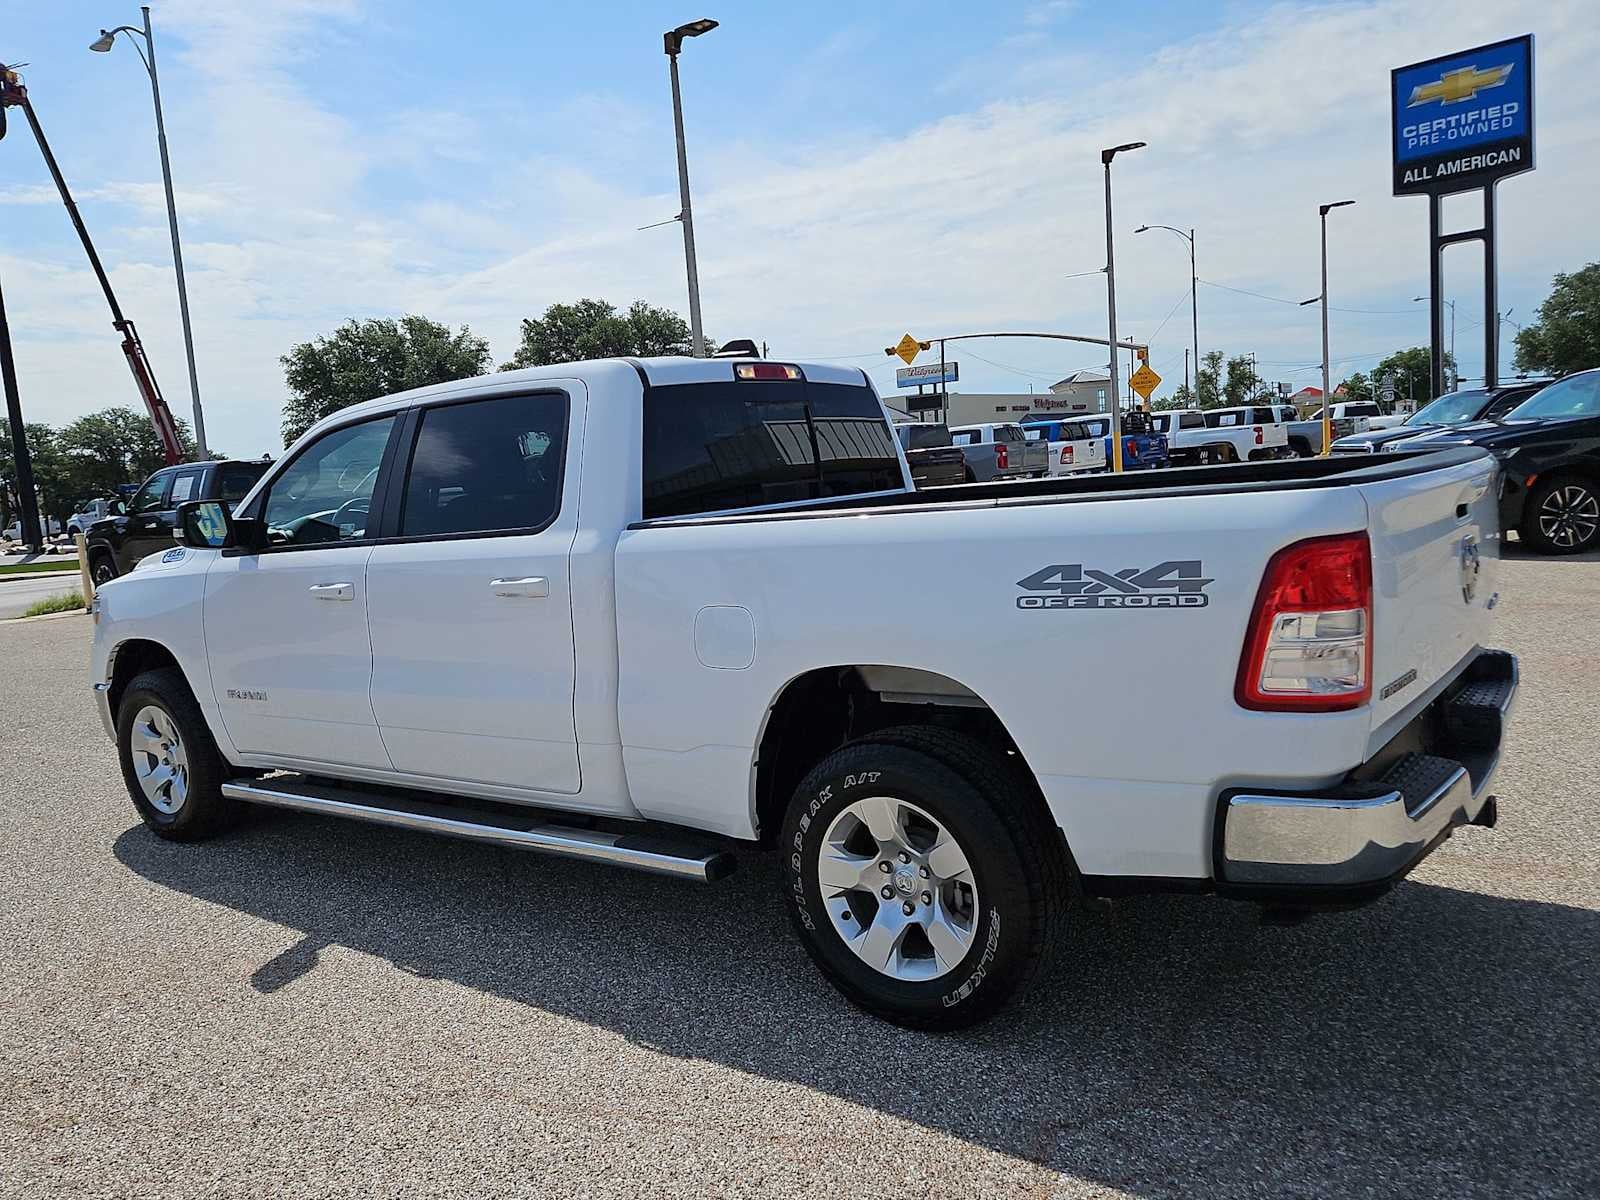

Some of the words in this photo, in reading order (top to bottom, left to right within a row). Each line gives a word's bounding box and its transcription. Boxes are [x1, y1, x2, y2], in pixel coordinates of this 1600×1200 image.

[1403, 102, 1519, 138] CERTIFIED
[1408, 116, 1513, 149] PRE-OWNED
[1403, 167, 1433, 184] ALL
[1436, 147, 1521, 178] AMERICAN
[1019, 596, 1089, 608] OFF
[1097, 595, 1205, 608] ROAD
[791, 785, 833, 931] WILDPEAK
